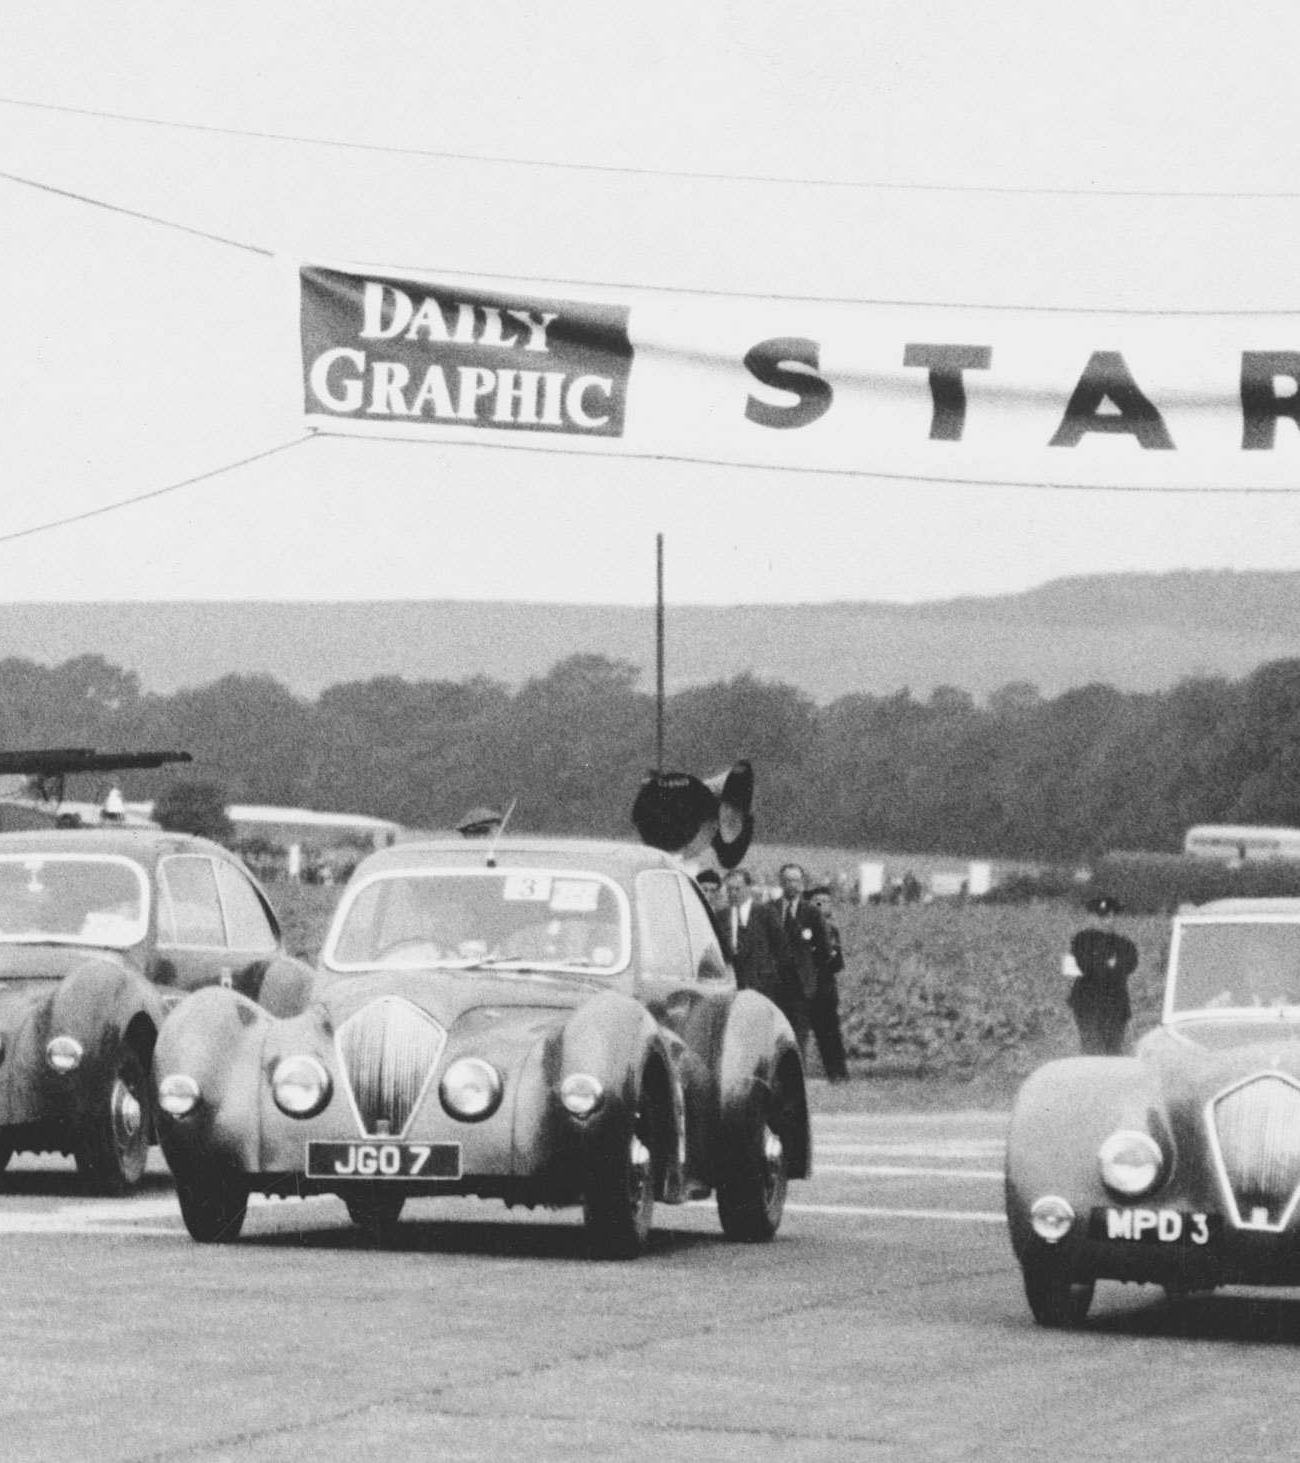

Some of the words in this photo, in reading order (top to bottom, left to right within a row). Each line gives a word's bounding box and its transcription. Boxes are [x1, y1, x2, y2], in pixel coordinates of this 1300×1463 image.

[359, 281, 558, 352] DAILY
[310, 347, 613, 428] GRAPHIC
[334, 1145, 401, 1175] JGO
[409, 1146, 432, 1175] 7
[1107, 1208, 1182, 1242] MPD
[1191, 1213, 1209, 1245] 3
